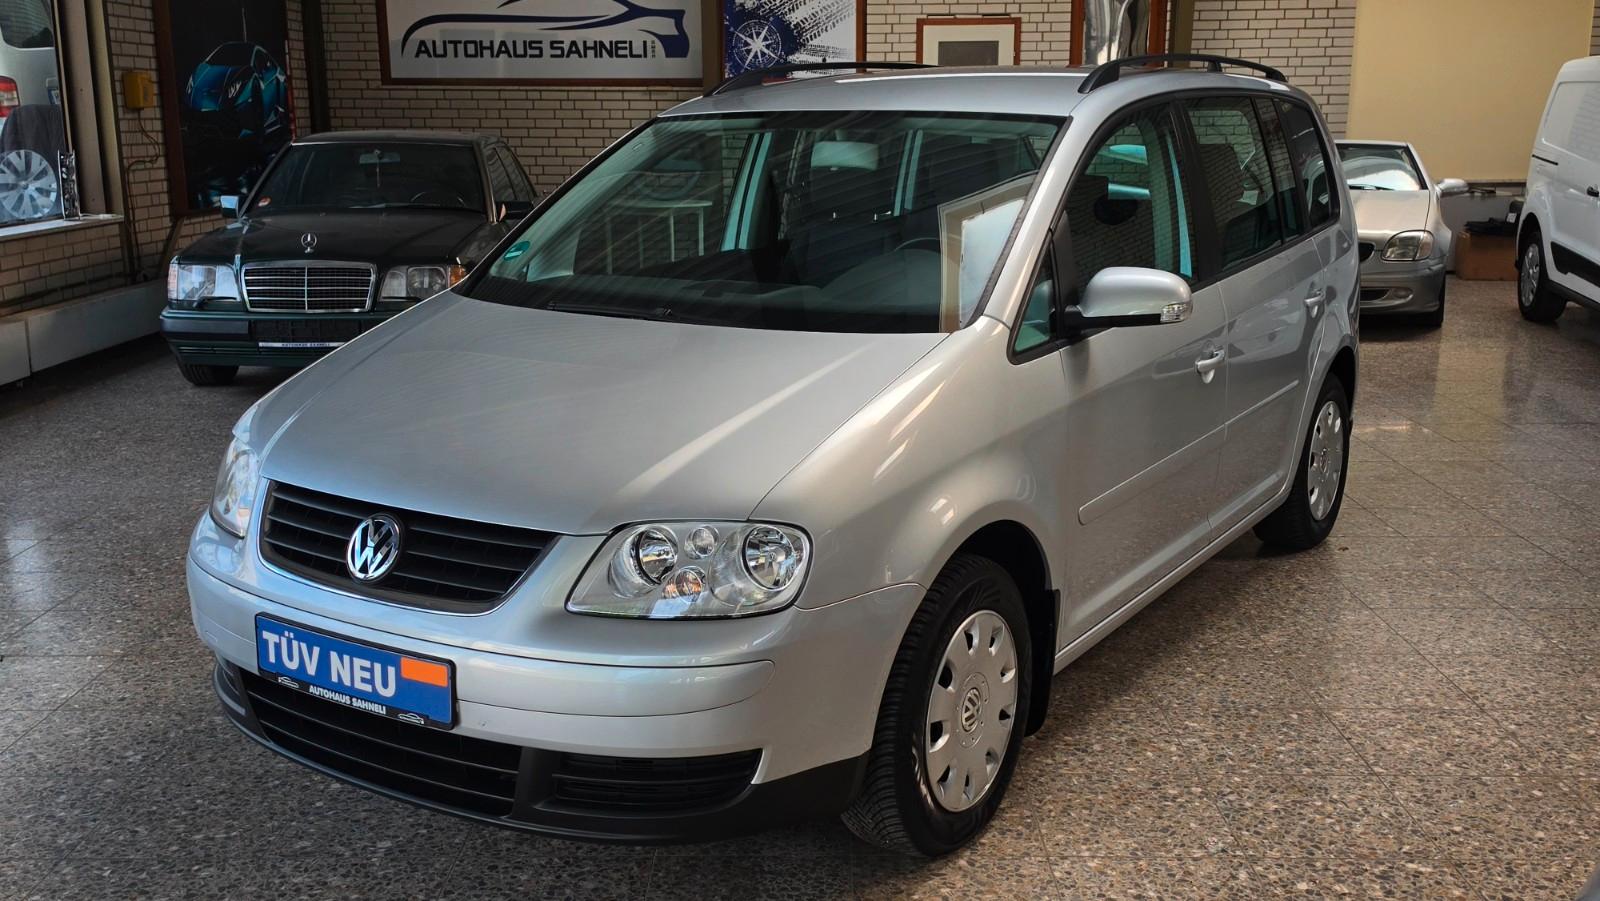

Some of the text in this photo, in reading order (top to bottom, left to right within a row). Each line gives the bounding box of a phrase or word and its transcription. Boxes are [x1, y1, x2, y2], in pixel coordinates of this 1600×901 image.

[415, 40, 543, 58] AUTOHAUS
[549, 40, 647, 58] SAHNELI
[349, 519, 397, 578] VW
[262, 630, 396, 697] TÜV NEU
[309, 685, 386, 715] AUTOHAUS SAHNELI
